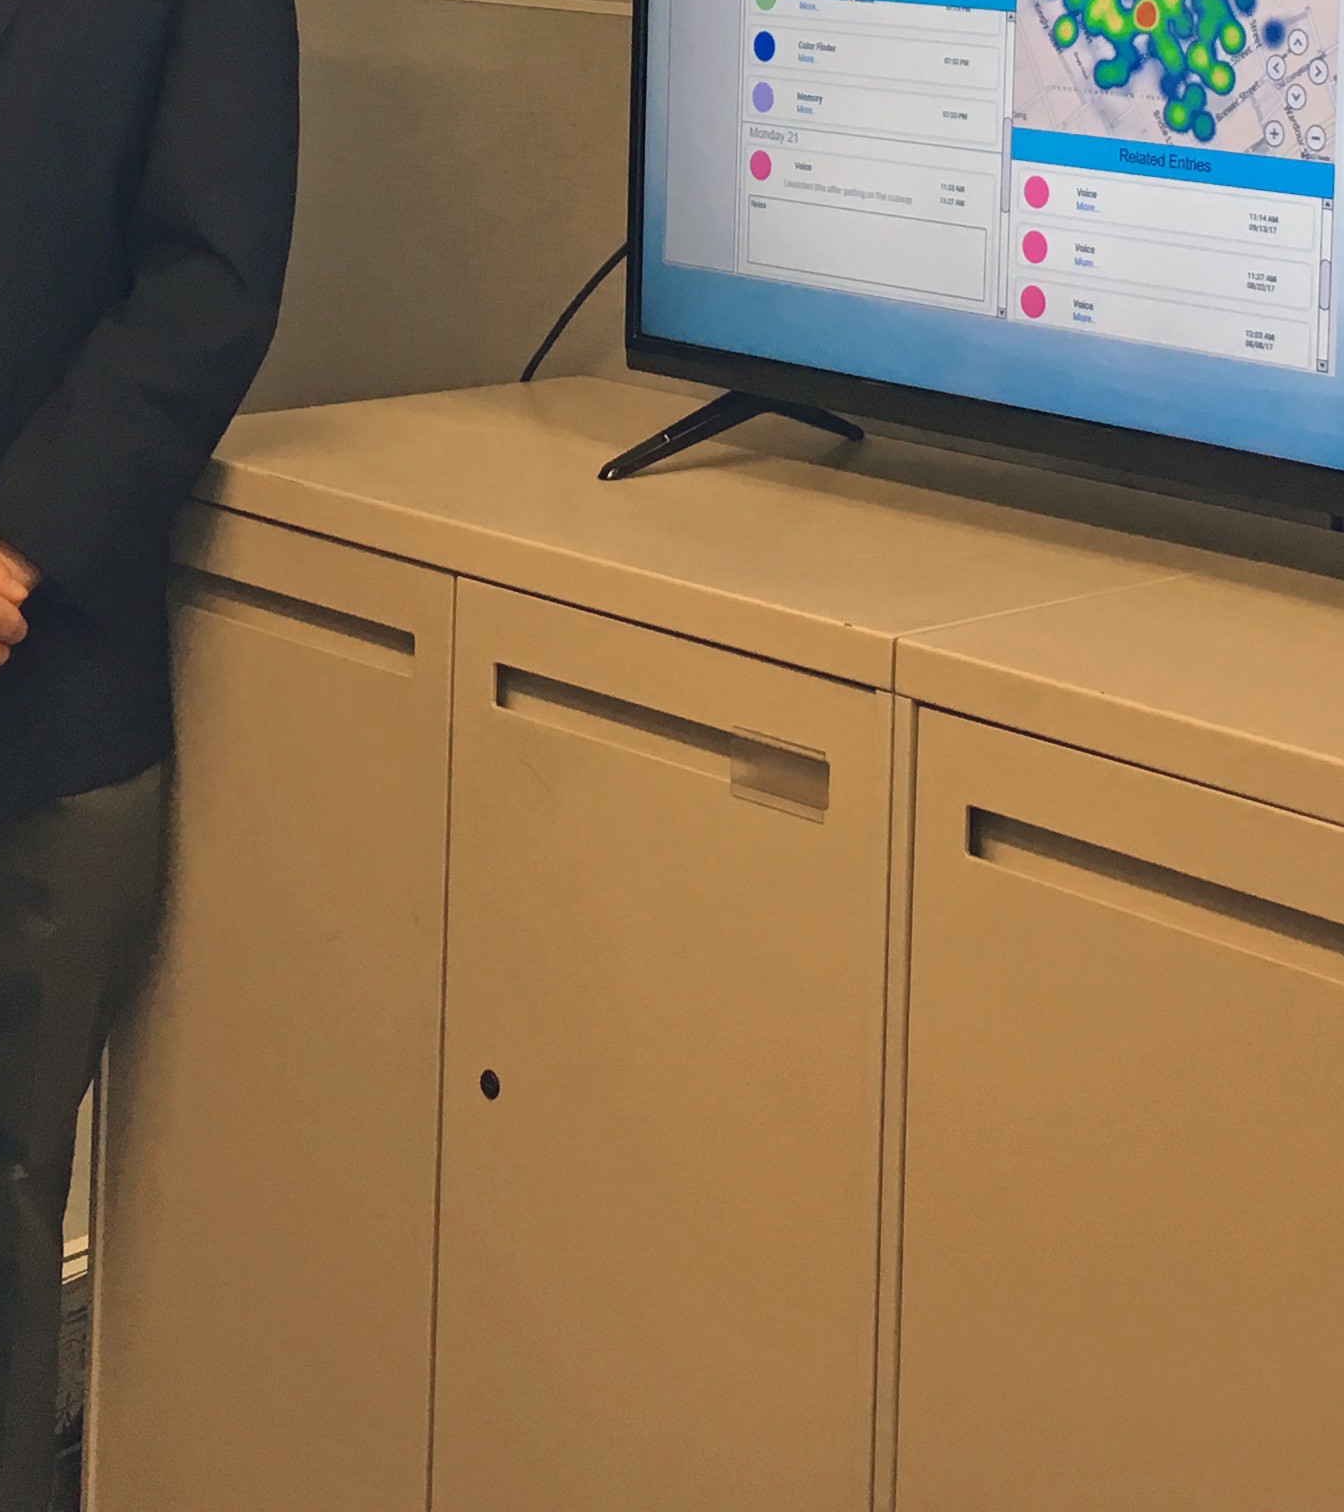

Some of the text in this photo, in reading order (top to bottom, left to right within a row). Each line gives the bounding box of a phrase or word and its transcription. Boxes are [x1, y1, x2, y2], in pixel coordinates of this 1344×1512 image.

[749, 126, 799, 144] Monday 21
[1119, 147, 1212, 174] Related Entries
[1076, 187, 1098, 199] Voice
[1074, 243, 1096, 255] Voice
[1072, 298, 1094, 311] Voice
